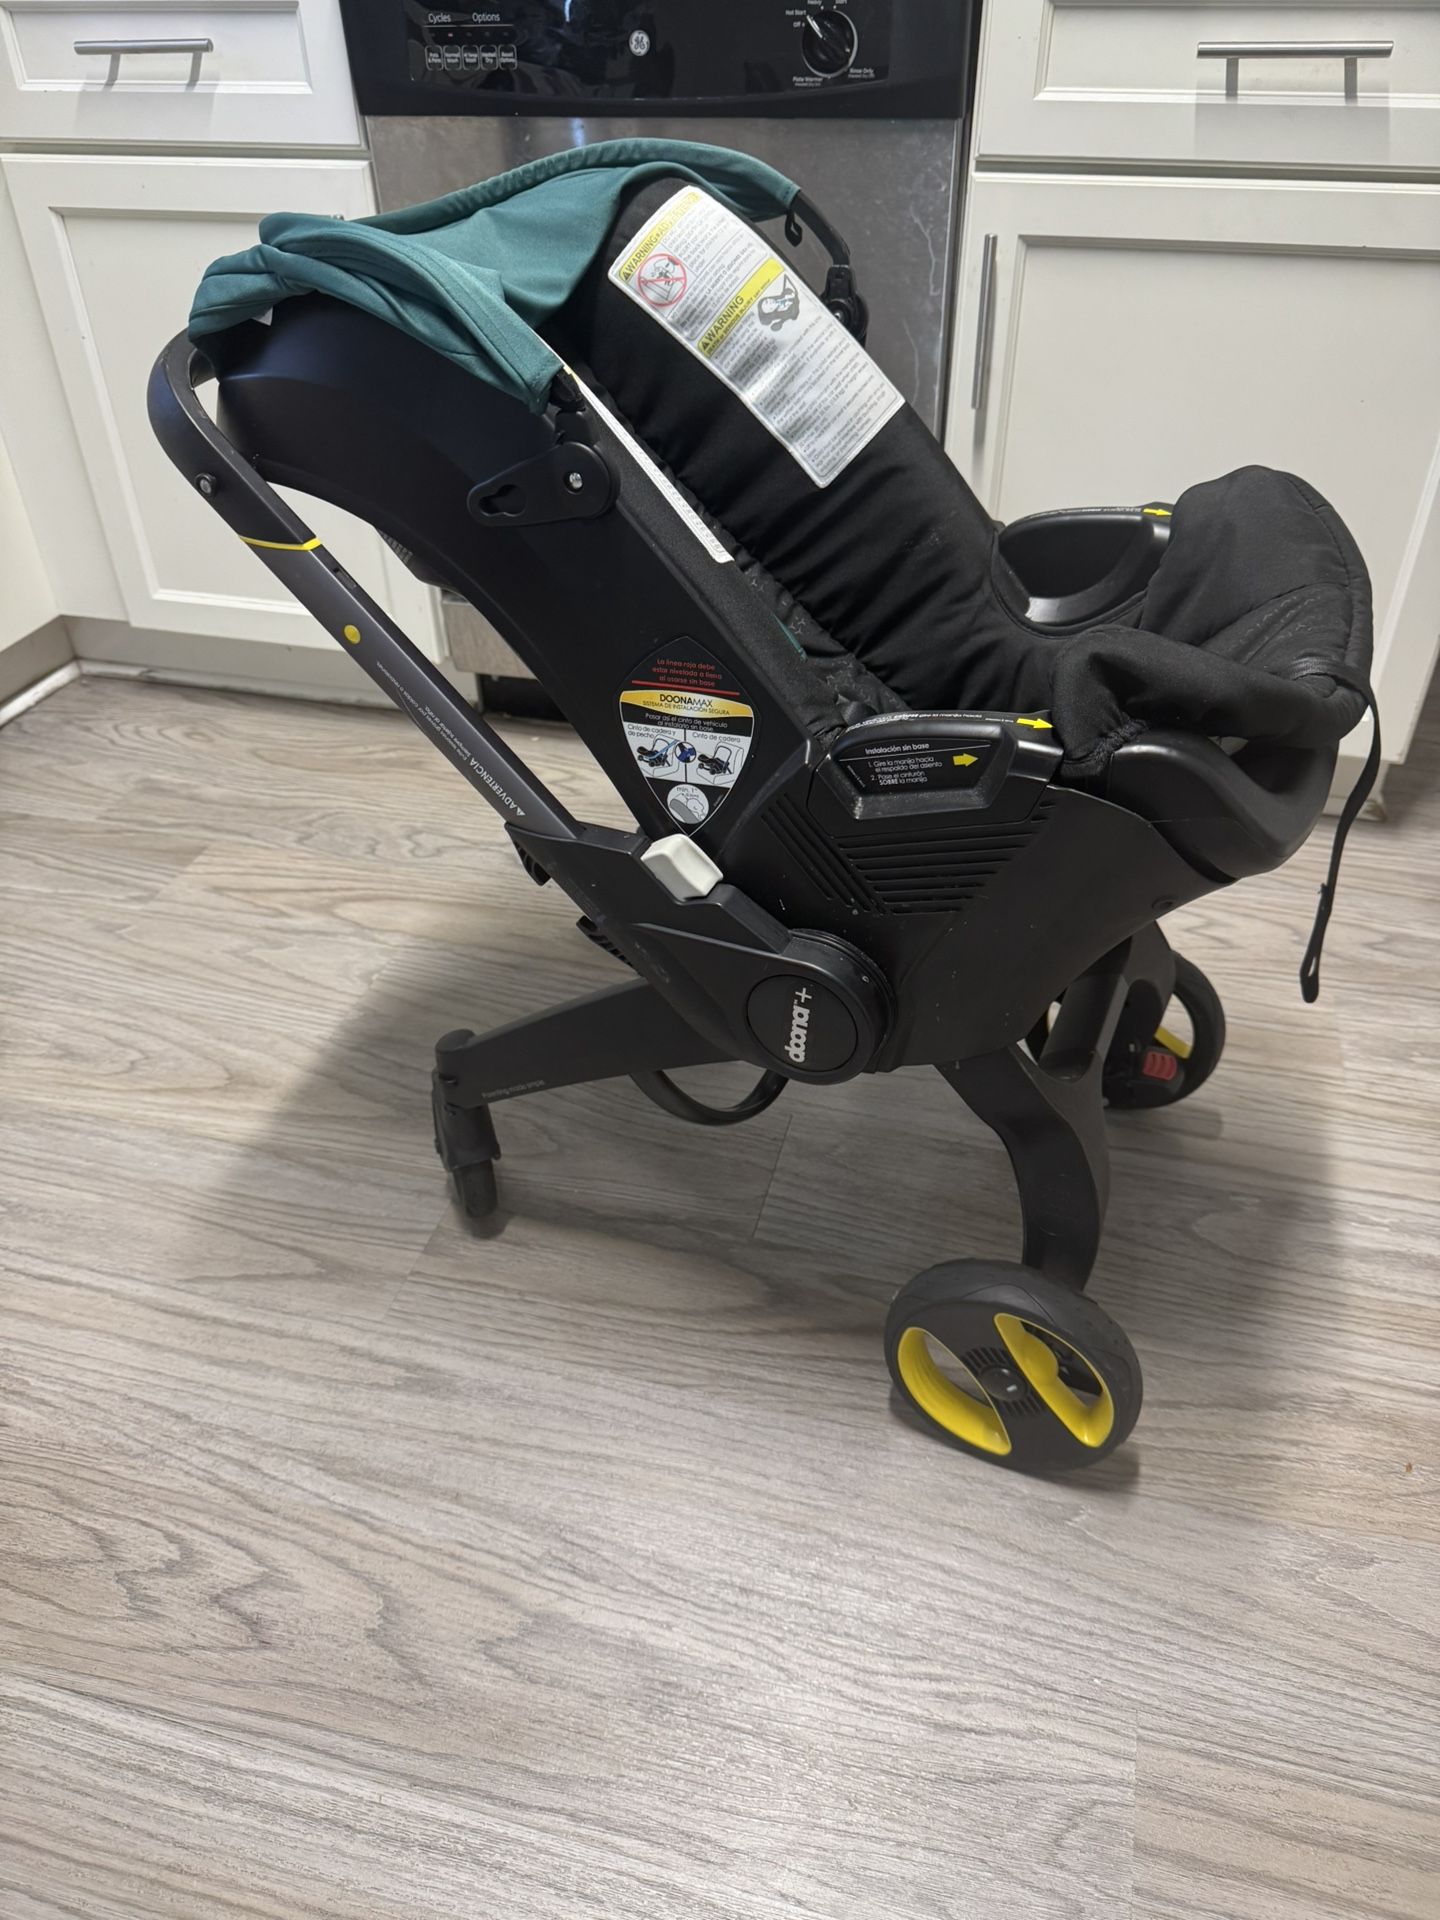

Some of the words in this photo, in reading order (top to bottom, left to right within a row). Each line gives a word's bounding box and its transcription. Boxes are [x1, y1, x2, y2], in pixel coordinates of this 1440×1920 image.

[428, 13, 451, 24] Cycles
[472, 12, 500, 23] Options
[626, 235, 657, 272] WARNING
[705, 296, 744, 341] WARNING
[660, 694, 712, 707] DOONAMAX
[678, 716, 693, 724] cinto
[652, 726, 671, 735] cadera
[692, 732, 708, 740] Cinto
[718, 734, 741, 742] cadera
[894, 758, 915, 766] manija
[881, 765, 908, 773] respaldo
[469, 757, 519, 809] ADVERTENCIA
